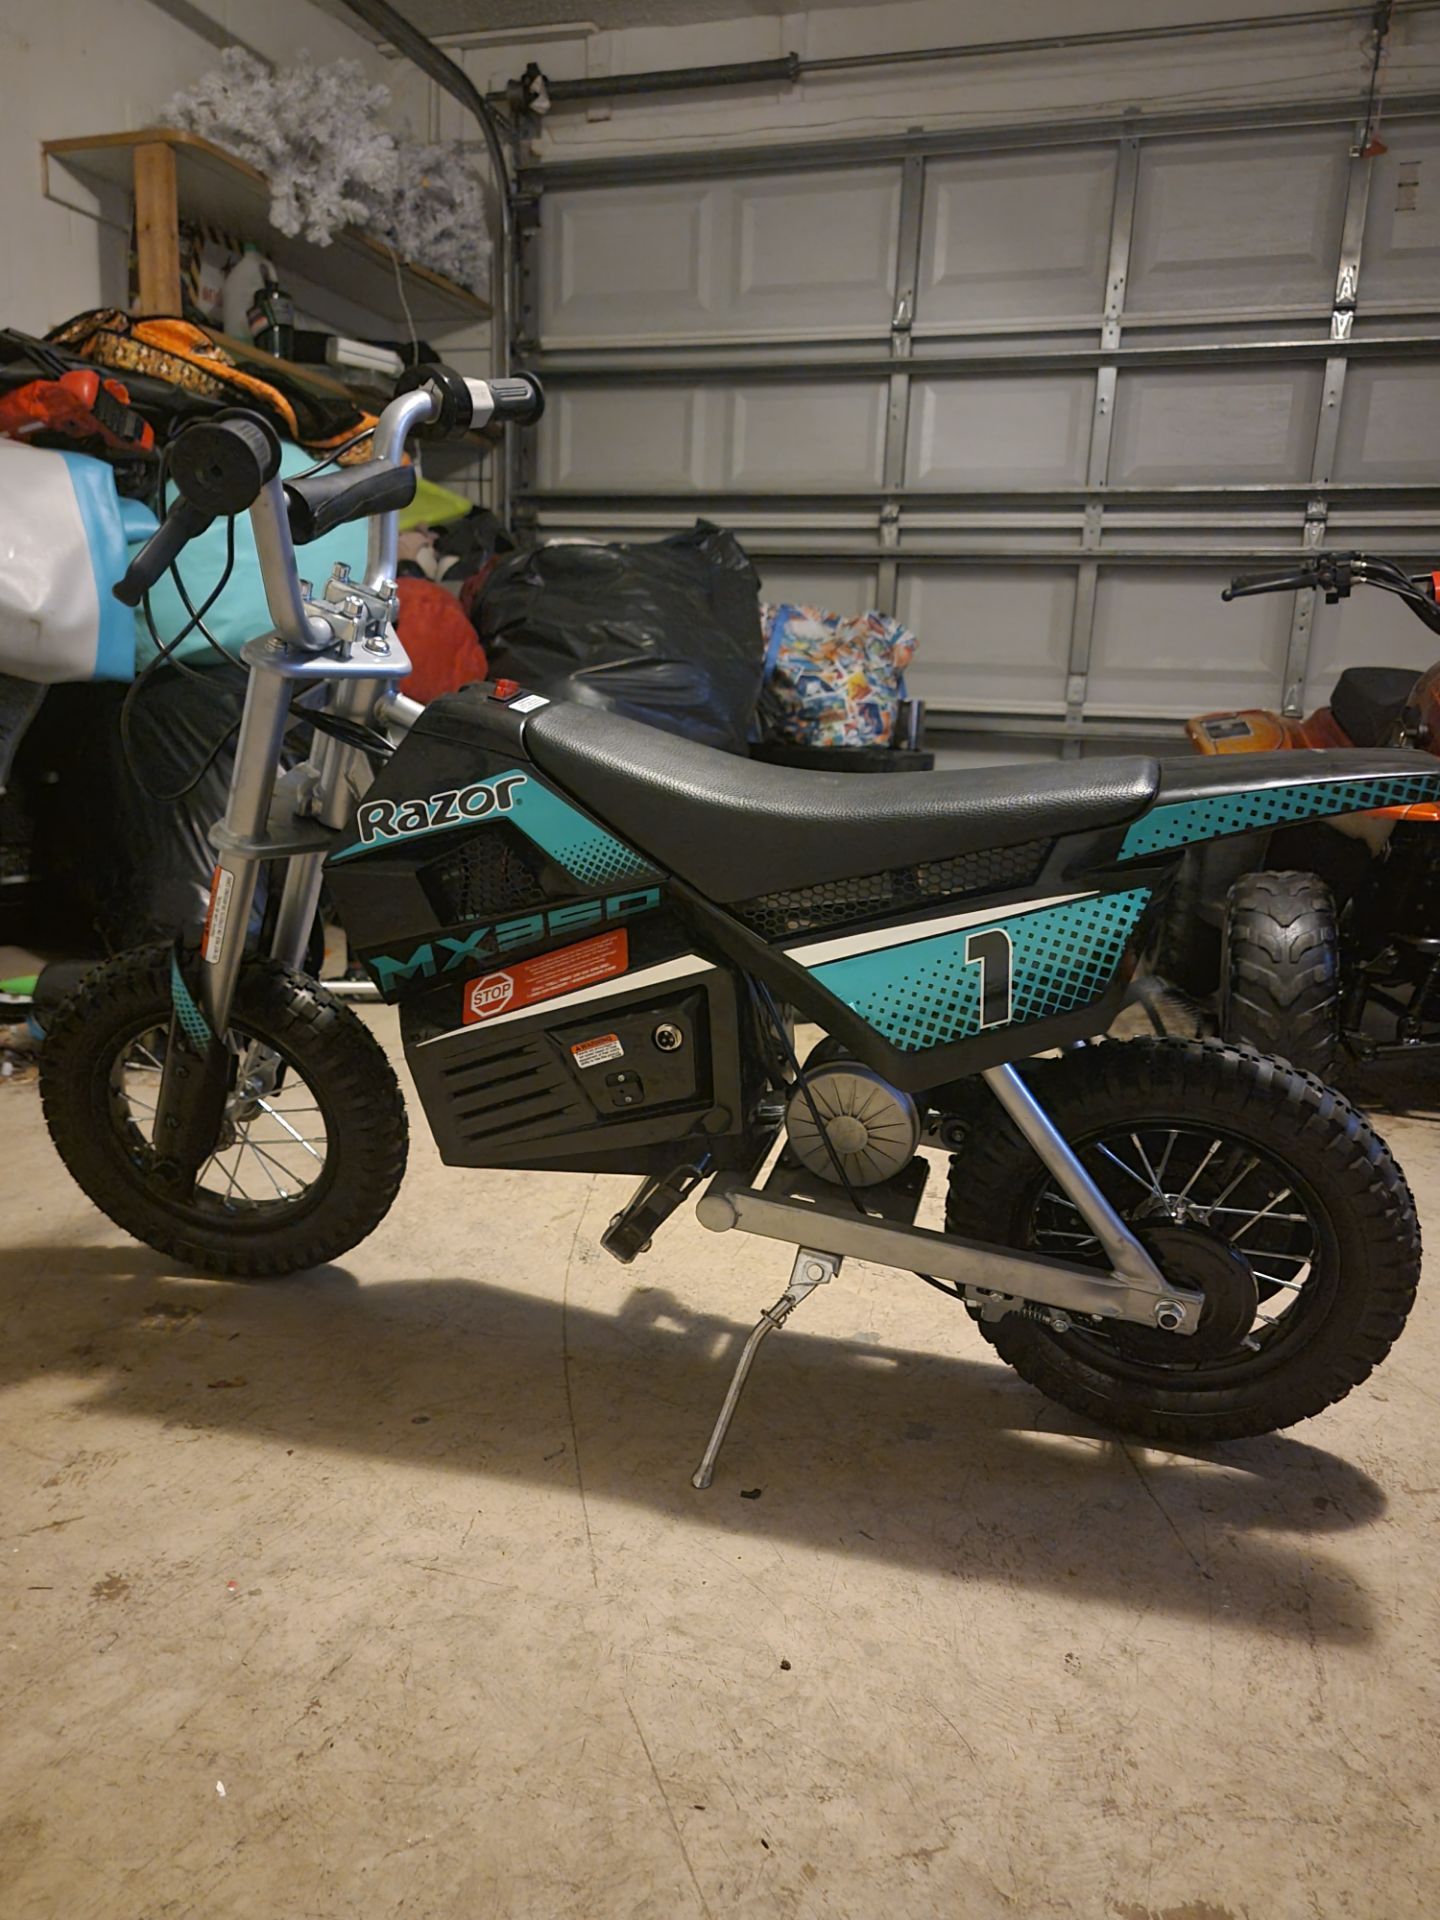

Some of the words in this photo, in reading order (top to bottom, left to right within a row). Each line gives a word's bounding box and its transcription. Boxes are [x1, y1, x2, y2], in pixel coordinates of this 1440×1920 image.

[357, 776, 527, 843] Razor
[371, 889, 660, 992] MX350
[966, 928, 1013, 1028] 1
[473, 982, 512, 1006] STOP
